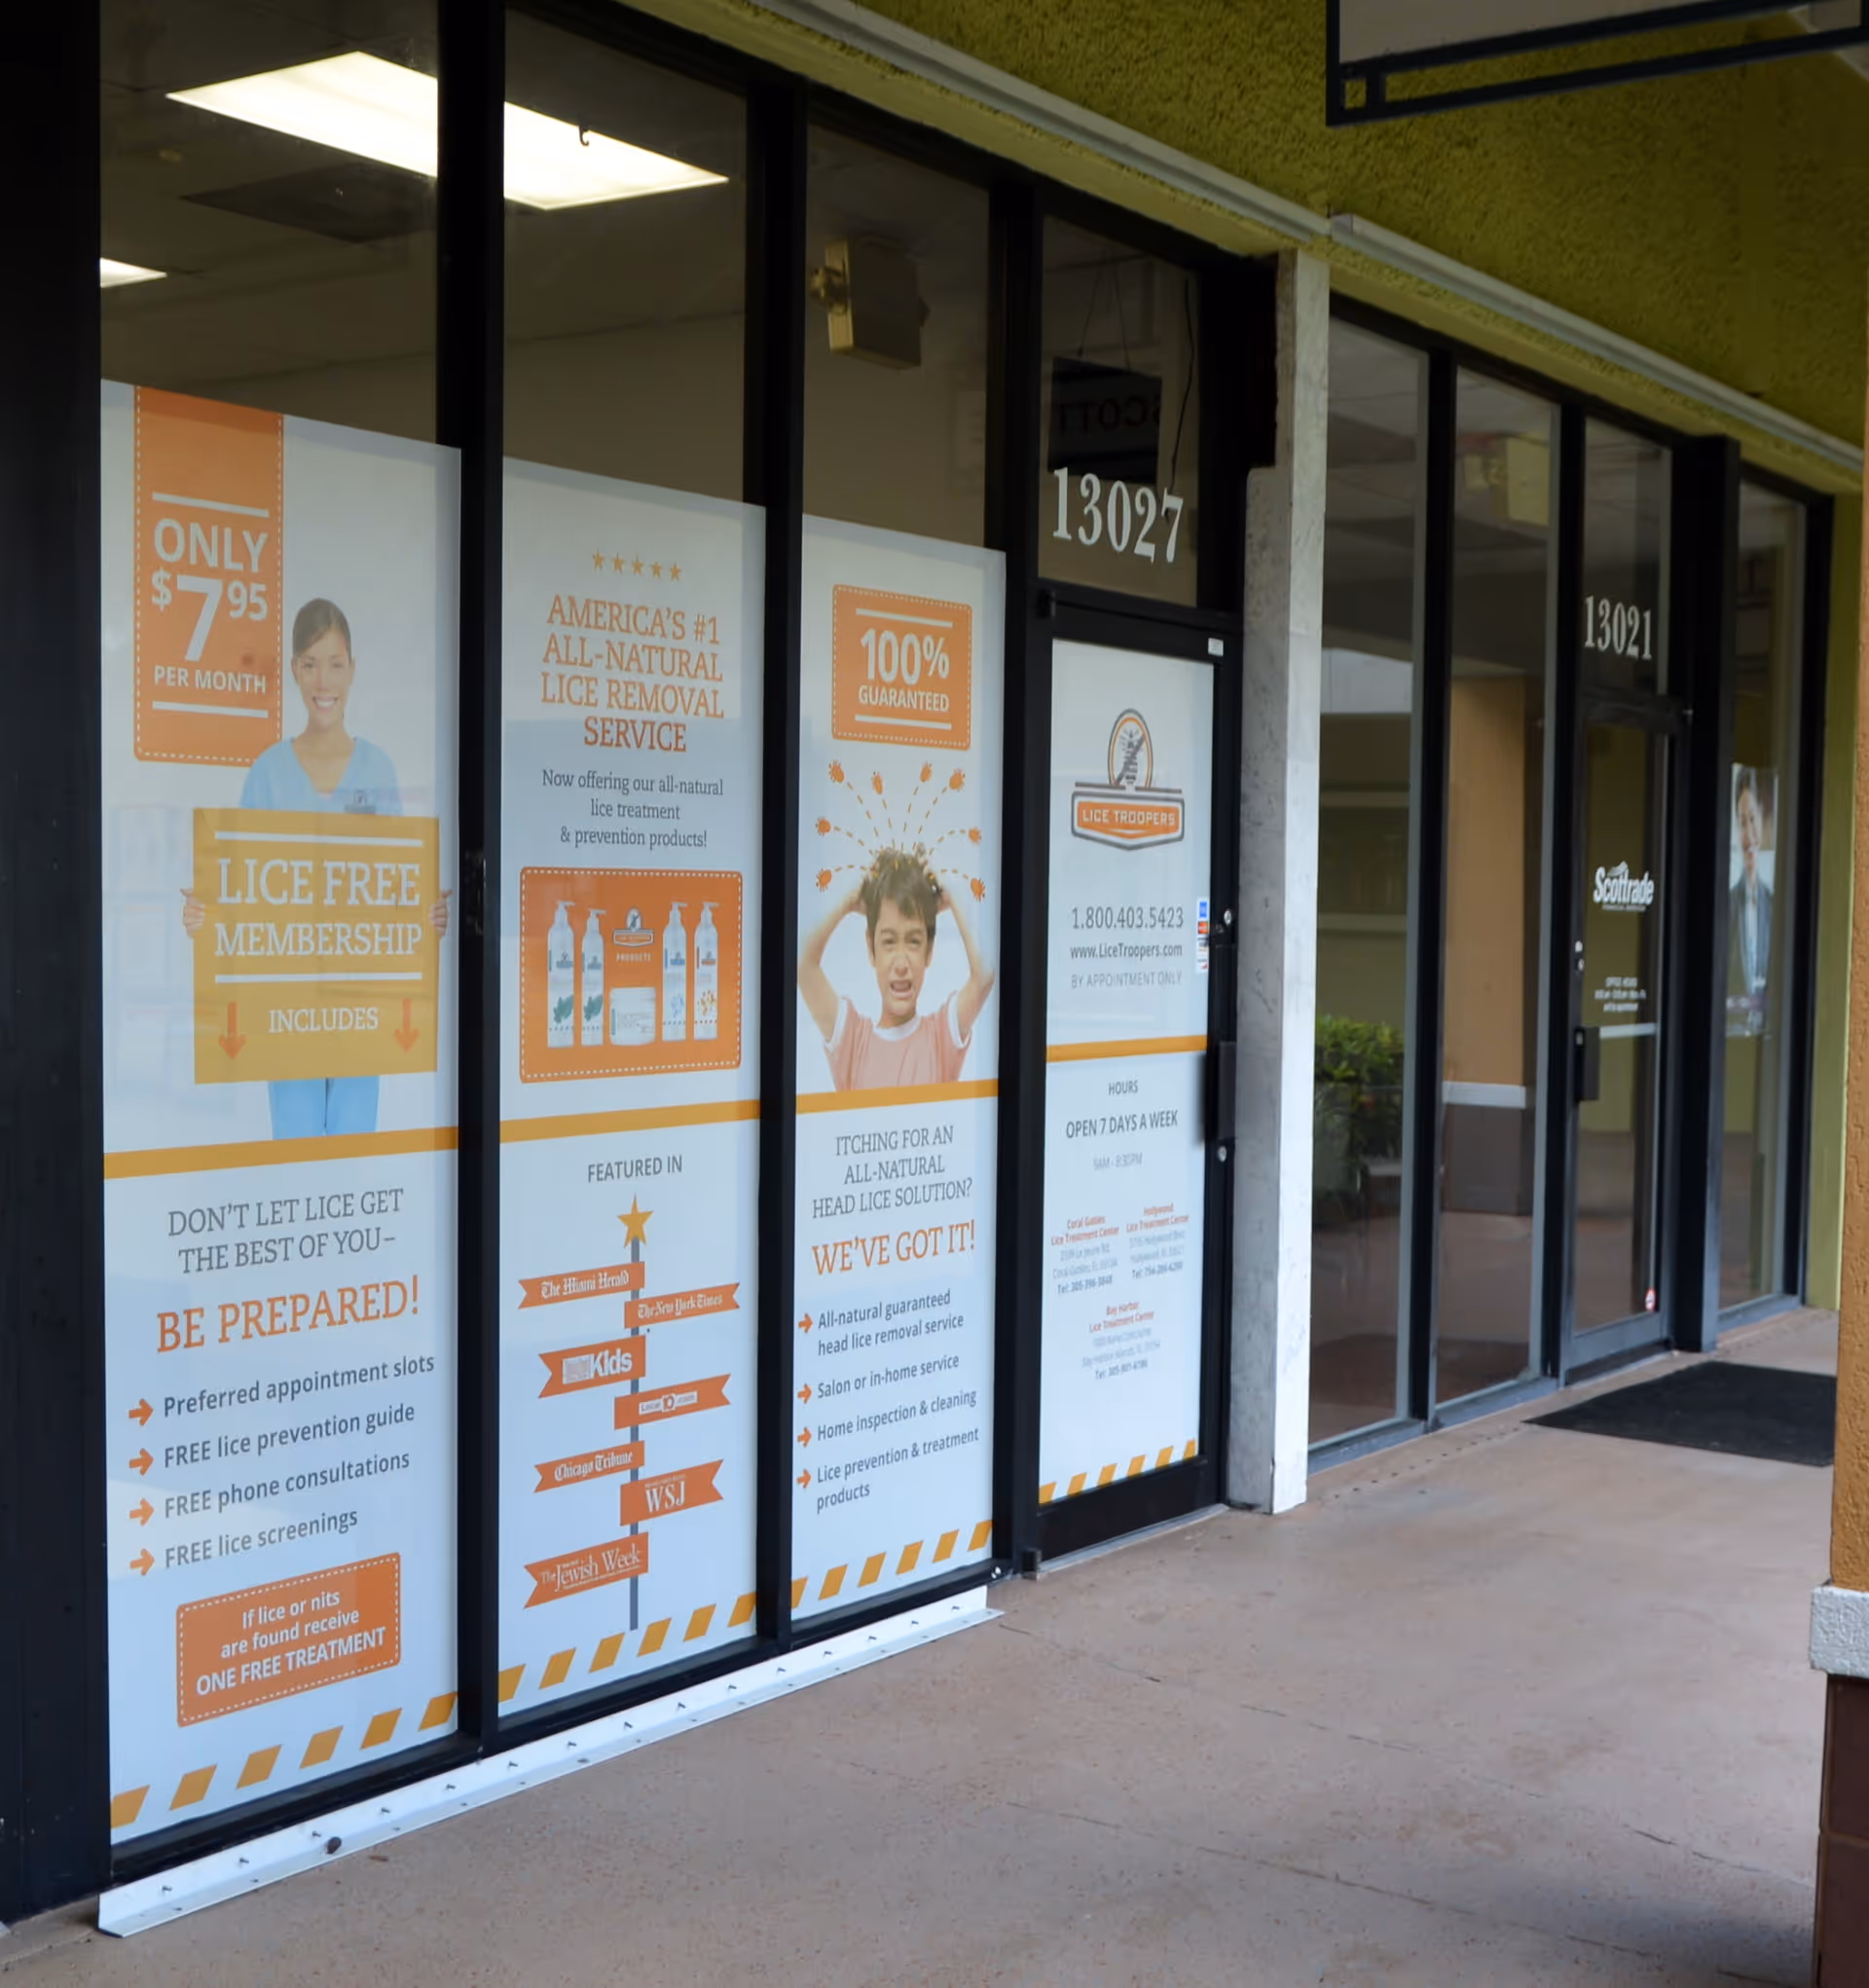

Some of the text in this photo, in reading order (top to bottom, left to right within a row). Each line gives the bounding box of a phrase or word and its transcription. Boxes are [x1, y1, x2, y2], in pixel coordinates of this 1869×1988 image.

[1053, 466, 1184, 564] 13027
[154, 518, 268, 572] ONLY
[546, 594, 720, 644] AMERICA'S #1
[1585, 595, 1652, 660] 13021
[542, 633, 723, 682] ALL-NATURAL
[861, 628, 950, 686] 100%
[154, 664, 266, 694] PER MONTH
[540, 672, 724, 718] LICE REMOVAL
[859, 684, 950, 713] GUARANTEED
[584, 716, 686, 753] SERVICE
[542, 769, 723, 795] Now offering our all-natural
[590, 799, 680, 821] lice treatment
[1082, 809, 1176, 828] LICE TROOPERS
[560, 826, 708, 851] & prevention products!
[217, 858, 421, 907] LICE FREE
[1593, 865, 1655, 905] Scottrade
[1072, 905, 1184, 930] 1.800.403.5423
[215, 922, 422, 957] MEMBERSHIP
[1070, 941, 1183, 960] www.LiceTroopers.com
[1072, 970, 1183, 989] BY APPOINTMENT ONLY
[269, 1007, 378, 1033] INCLUDES
[1108, 1080, 1139, 1095] HOURS
[835, 1125, 954, 1157] ITCHING FOR AN
[1066, 1110, 1178, 1139] OPEN 7 DAYS A WEEK
[588, 1155, 682, 1183] FEATURED IN
[844, 1155, 945, 1185] ALL-NATURAL
[168, 1188, 403, 1236] DON'T LET LICE GET
[812, 1177, 973, 1219] HEAD LICE SOLUTION?
[179, 1245, 228, 1274] THE
[235, 1236, 293, 1268] BEST
[299, 1233, 328, 1259] OF
[812, 1219, 975, 1275] WE'VE GOT IT!
[540, 1270, 630, 1302] The Miami Herald
[638, 1293, 723, 1319] The New York Times
[157, 1274, 419, 1353] BE PREPARED!
[818, 1289, 951, 1330] All-natural guaranteed
[818, 1313, 964, 1356] head lice removal service
[589, 1347, 633, 1381] Kids
[818, 1354, 960, 1399] Salon or in-home service
[164, 1354, 434, 1417] Preferred appointment slots
[818, 1389, 976, 1441] Home inspection & cleaning
[164, 1404, 415, 1468] FREE lice prevention guide
[818, 1427, 979, 1484] Lice prevention & treatment
[164, 1451, 410, 1519] FREE phone consultations
[555, 1451, 633, 1483] Chicago Tribune
[645, 1481, 686, 1514] WSJ
[817, 1483, 870, 1515] products
[165, 1509, 358, 1569] FREE lice screenings
[555, 1555, 599, 1593] Jewish
[601, 1542, 641, 1573] Week
[241, 1590, 341, 1629] If lice or nits
[221, 1609, 359, 1659] are found receive
[196, 1627, 387, 1696] ONE FREE TREATMENT
